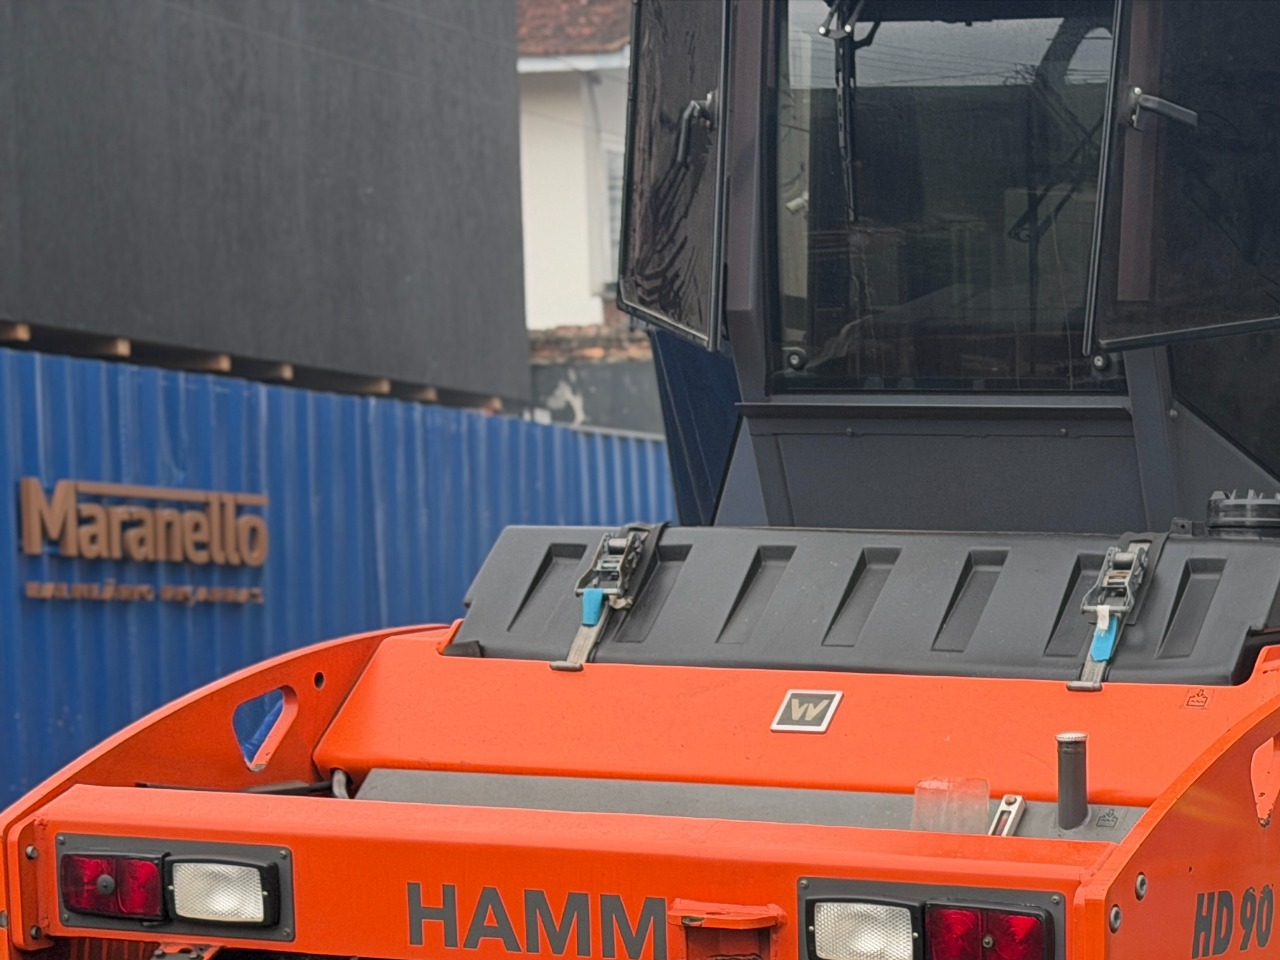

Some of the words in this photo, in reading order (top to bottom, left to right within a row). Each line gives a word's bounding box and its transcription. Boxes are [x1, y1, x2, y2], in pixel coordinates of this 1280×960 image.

[20, 477, 268, 566] Maranello
[1191, 890, 1234, 960] HD
[1239, 884, 1275, 951] 90
